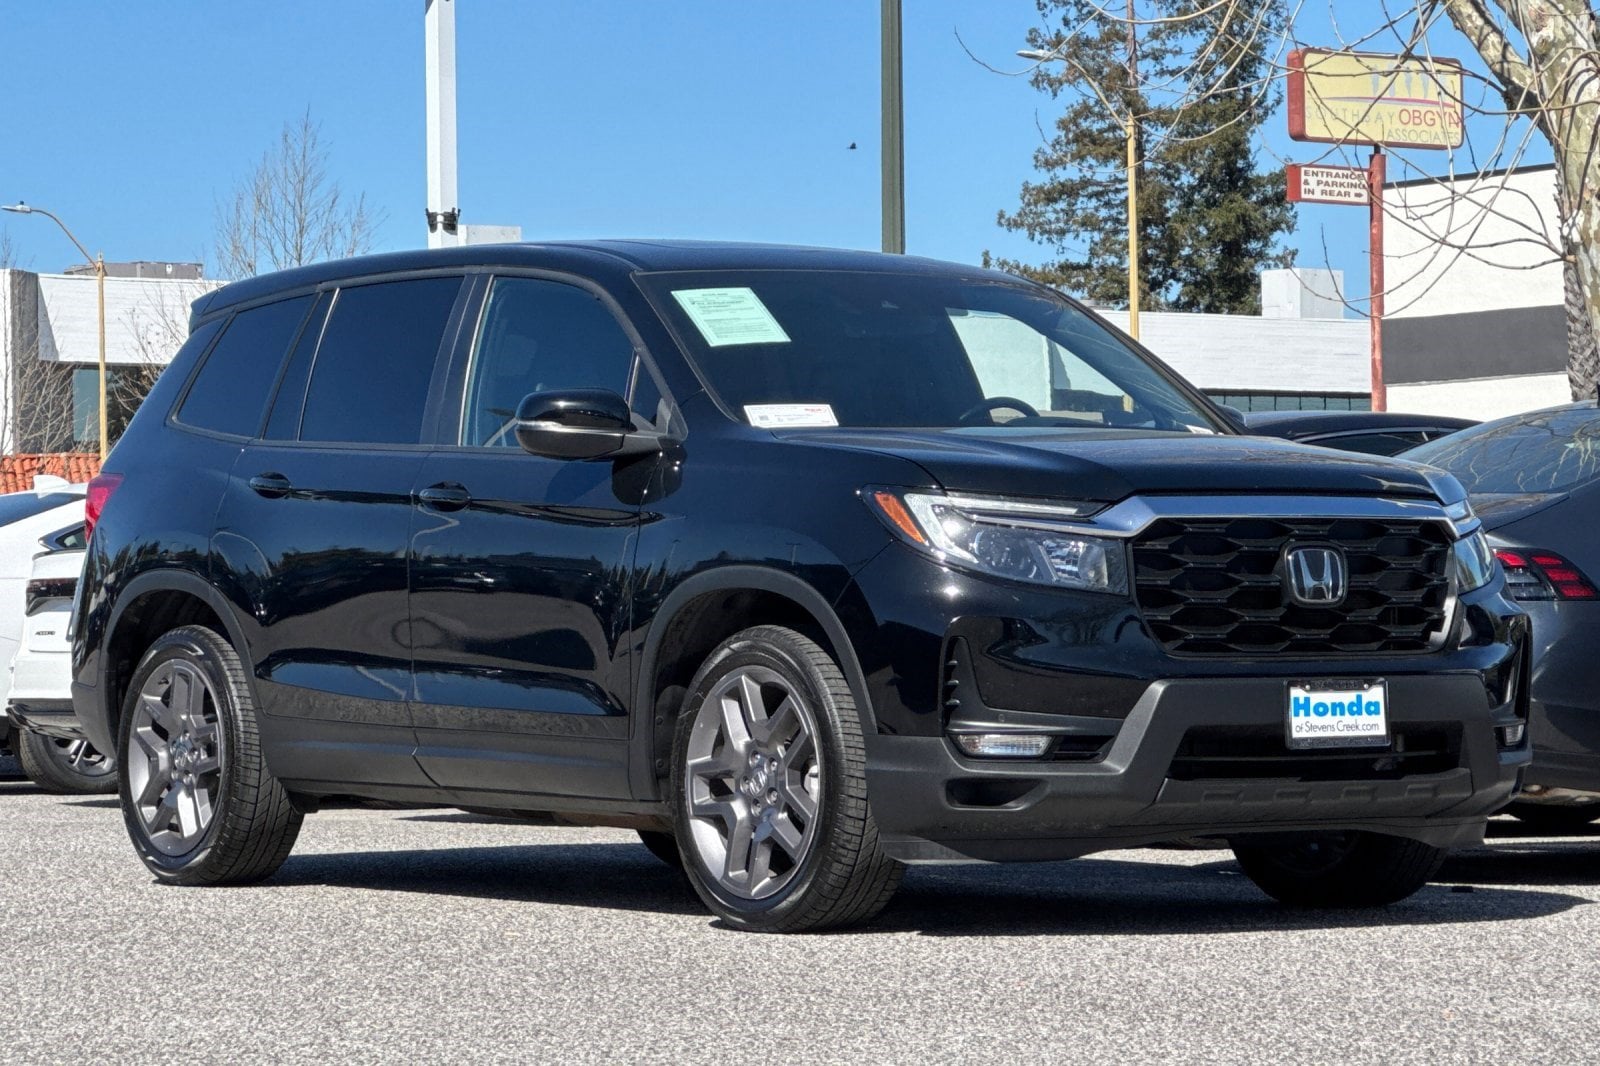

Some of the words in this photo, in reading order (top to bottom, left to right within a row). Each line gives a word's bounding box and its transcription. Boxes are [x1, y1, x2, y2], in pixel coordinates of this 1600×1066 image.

[1398, 108, 1460, 128] OBGYN
[1386, 127, 1460, 145] ASSOCIAES
[1303, 169, 1364, 181] ENTRANCE
[1316, 179, 1367, 190] PARKING
[1303, 187, 1315, 196] IN
[1320, 189, 1351, 198] REAR
[1292, 693, 1381, 718] Honda
[1295, 721, 1304, 733] of
